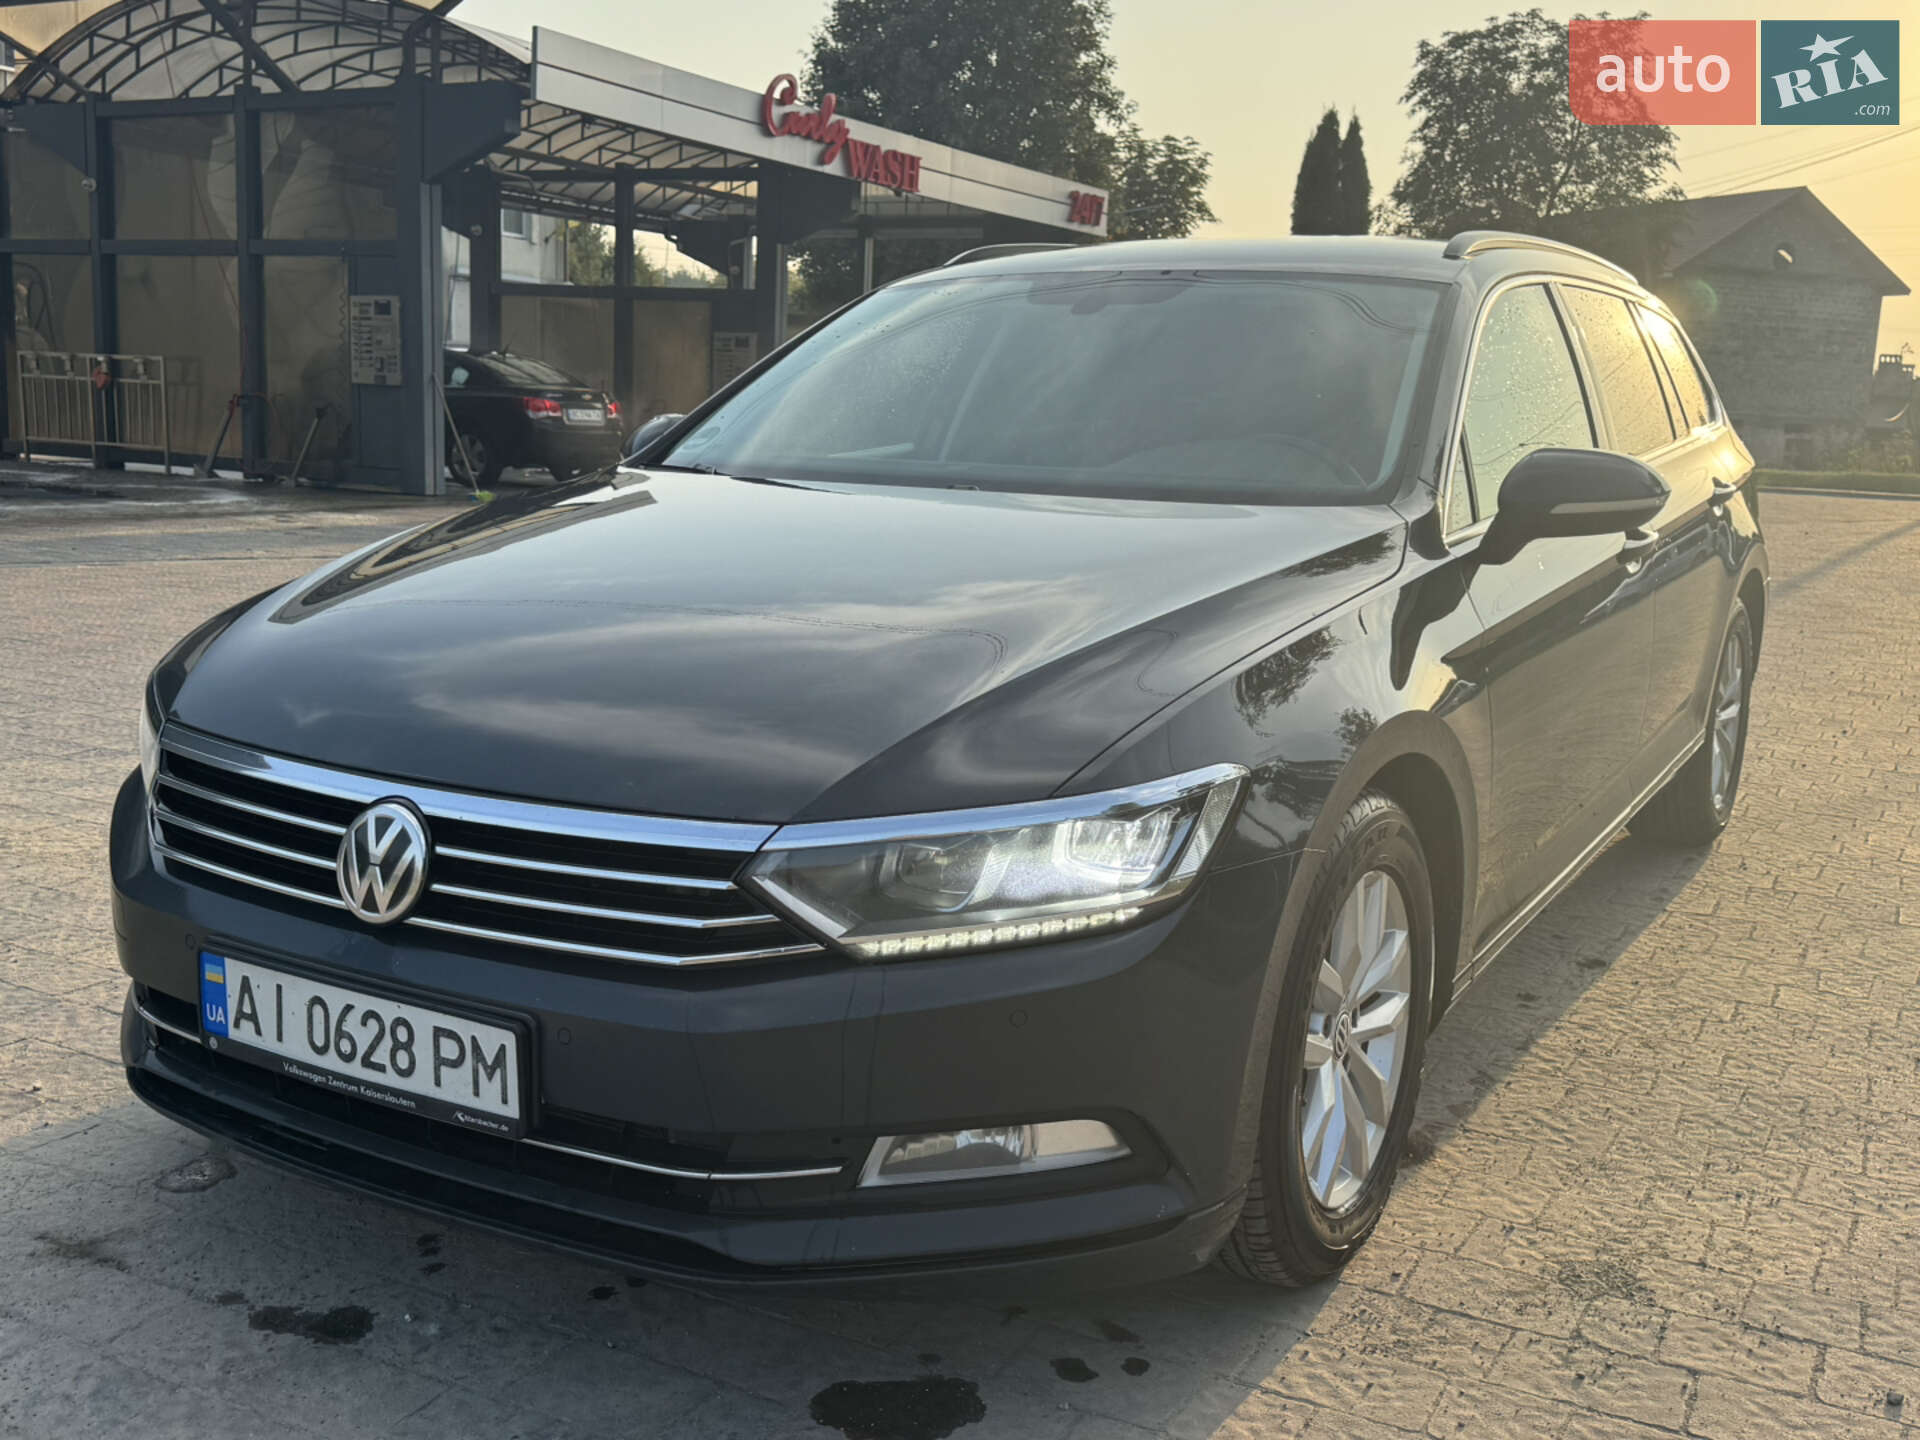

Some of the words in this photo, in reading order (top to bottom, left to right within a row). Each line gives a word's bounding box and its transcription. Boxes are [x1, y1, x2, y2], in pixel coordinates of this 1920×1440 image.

[848, 138, 922, 192] WASH
[206, 1003, 226, 1025] UA
[233, 975, 283, 1043] AI
[306, 995, 417, 1079] 0628
[433, 1025, 508, 1105] PM
